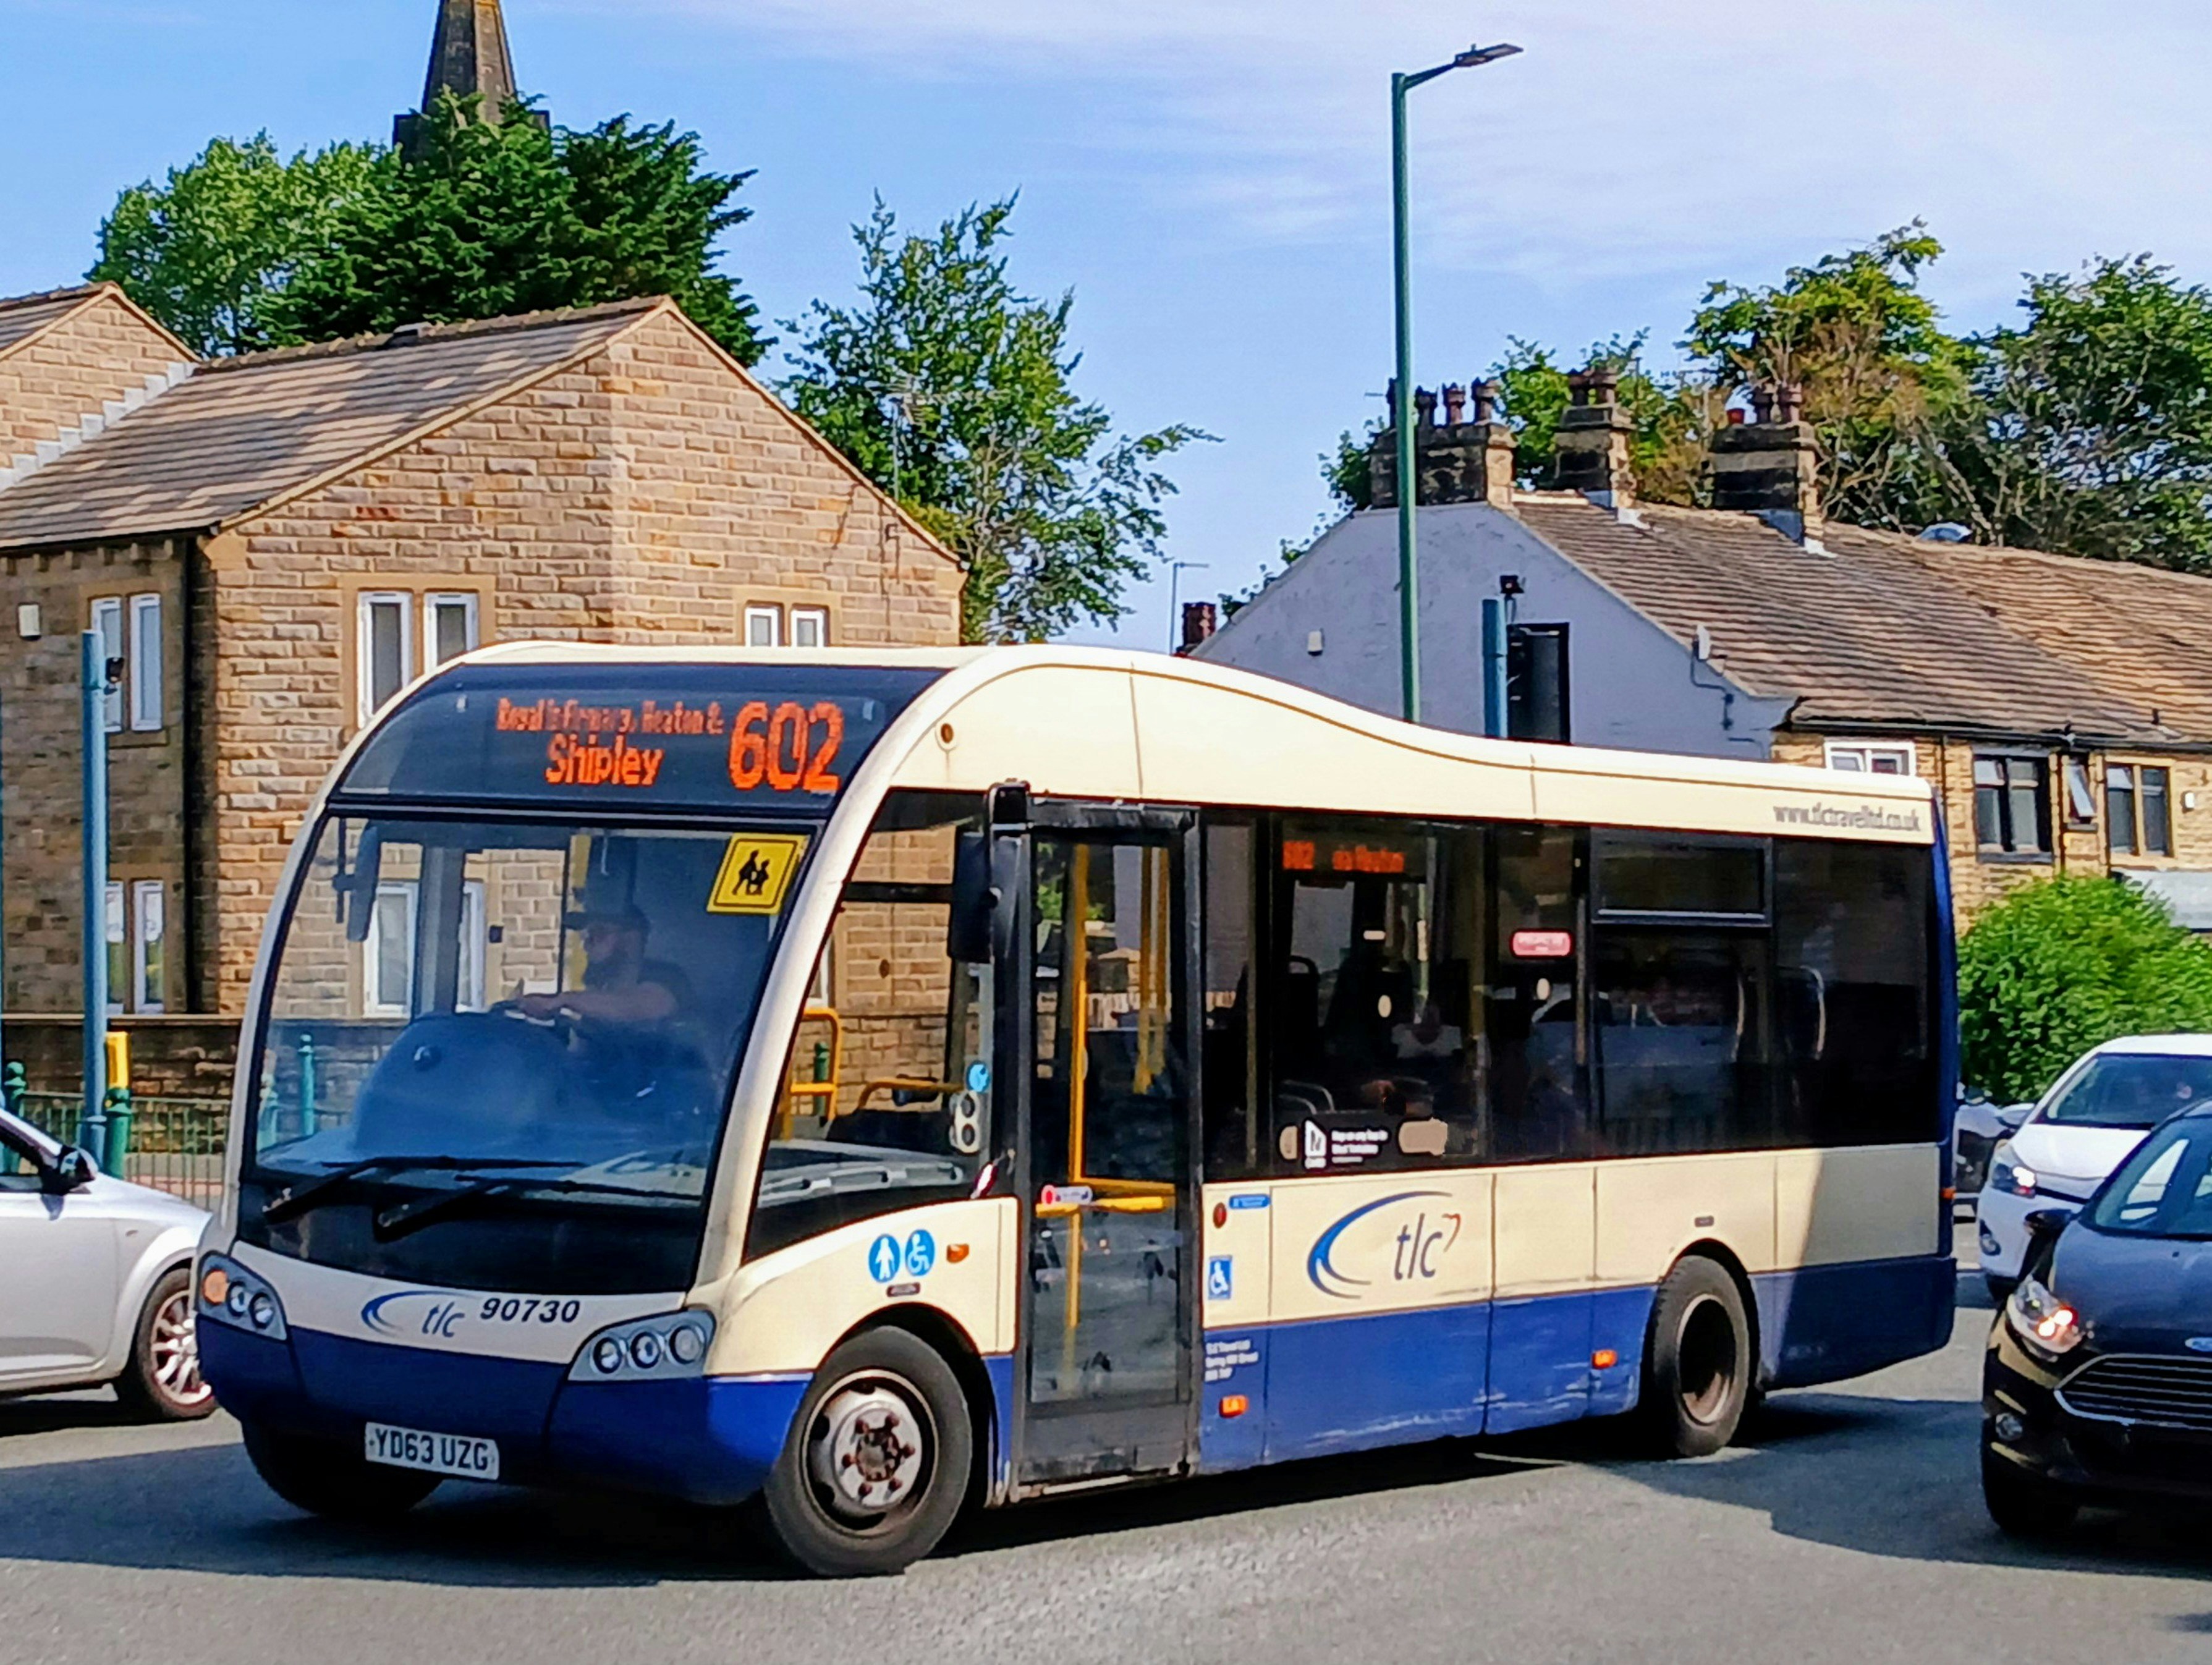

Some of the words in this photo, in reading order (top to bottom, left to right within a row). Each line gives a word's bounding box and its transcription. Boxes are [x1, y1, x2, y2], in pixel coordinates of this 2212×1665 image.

[545, 733, 665, 786] Shipley
[729, 701, 844, 791] 602
[1394, 1213, 1443, 1281] tlc
[422, 1301, 465, 1337] tlc
[480, 1297, 580, 1323] 90730
[375, 1428, 434, 1464] YD63
[440, 1438, 488, 1471] UZG
